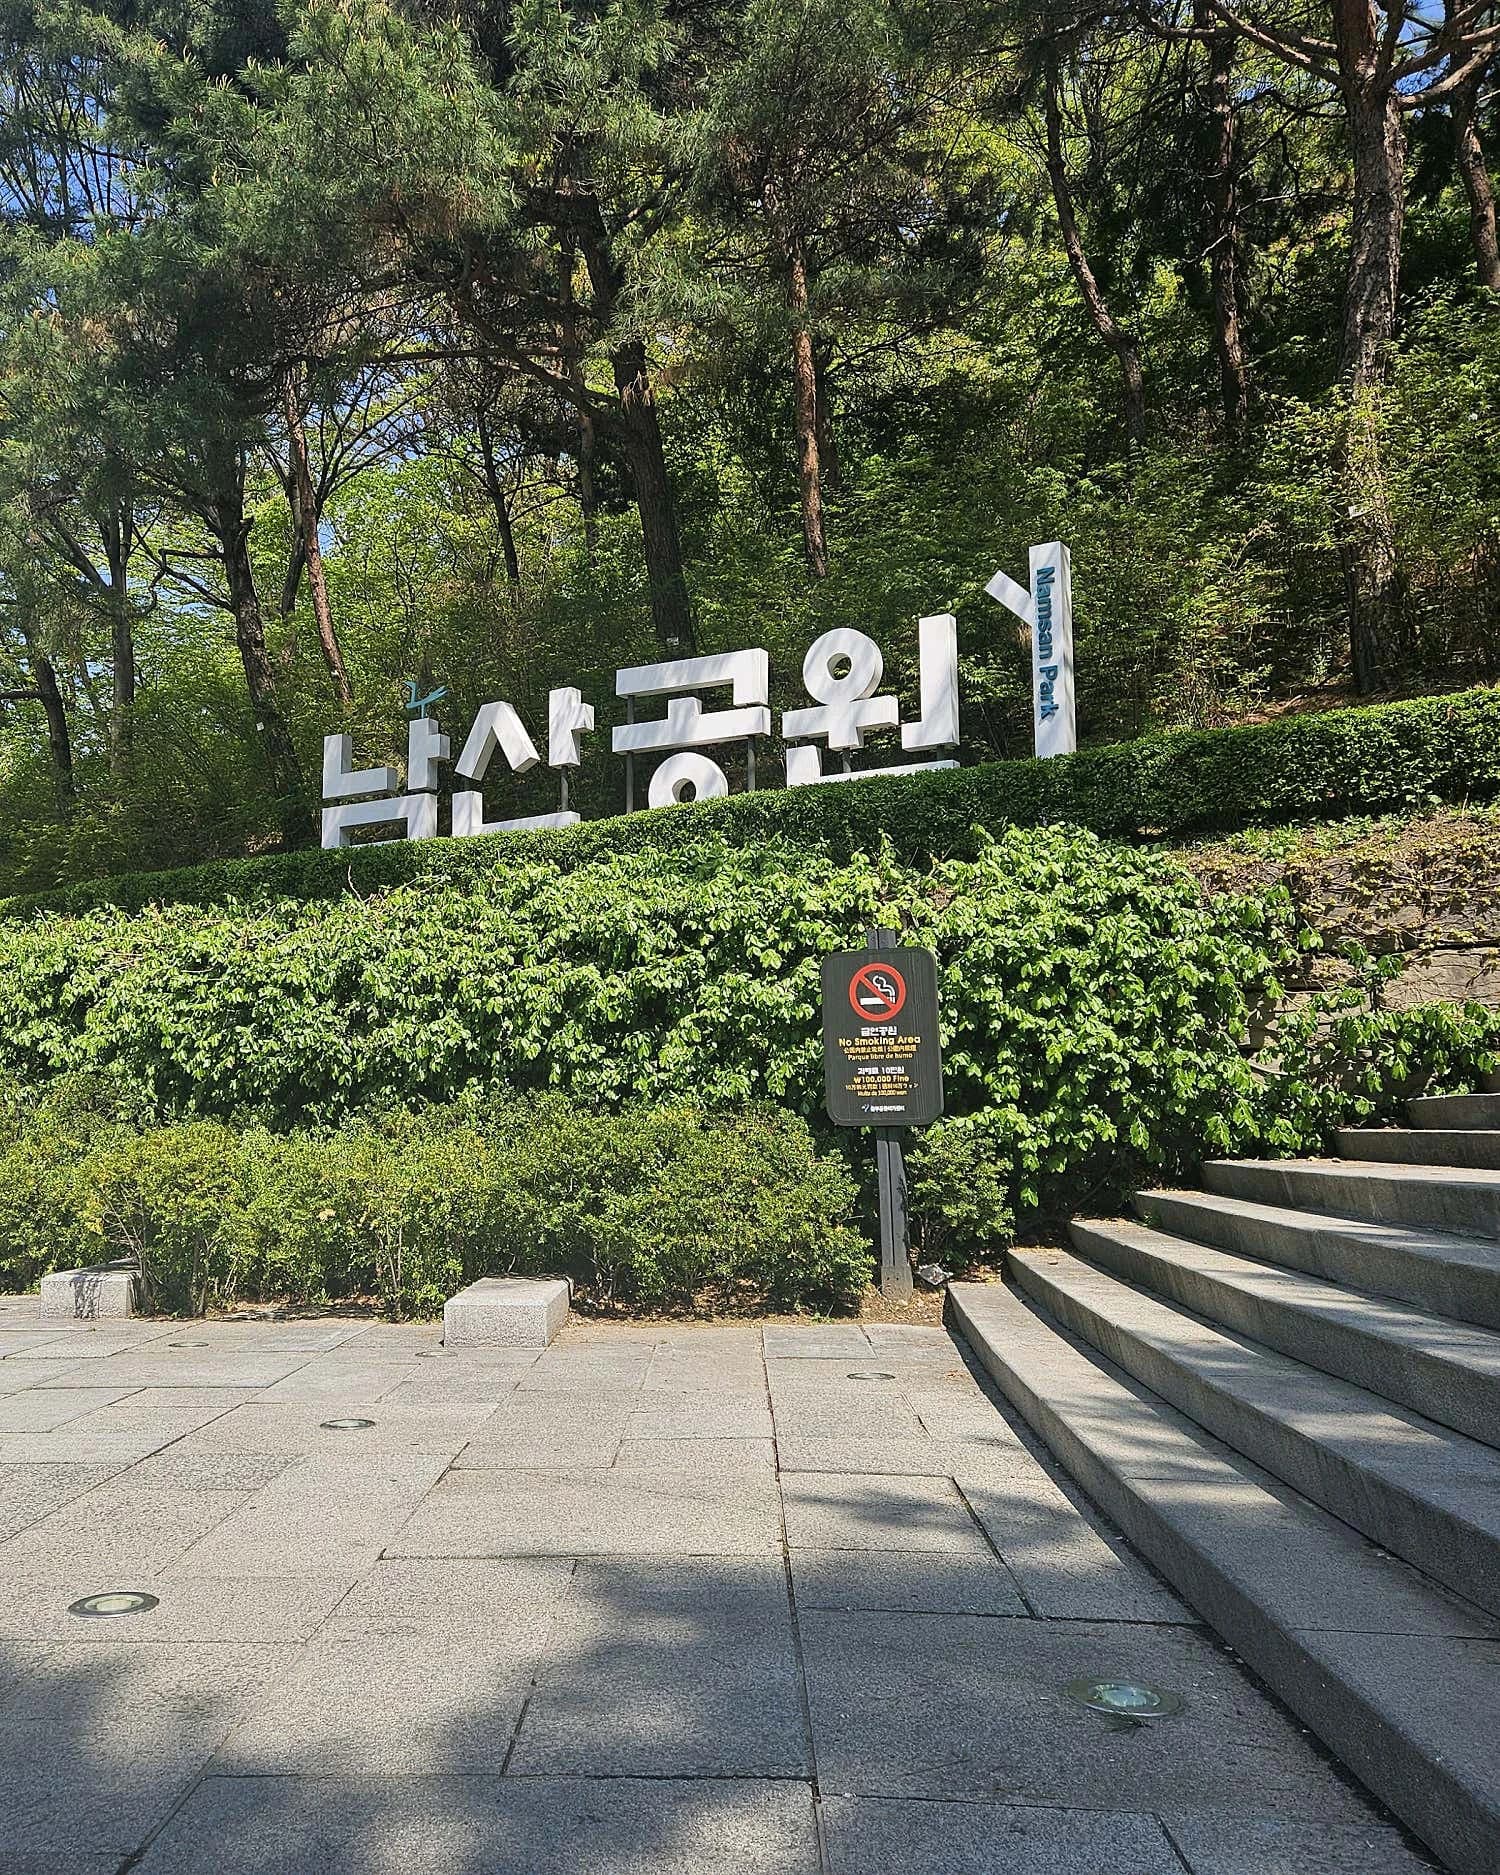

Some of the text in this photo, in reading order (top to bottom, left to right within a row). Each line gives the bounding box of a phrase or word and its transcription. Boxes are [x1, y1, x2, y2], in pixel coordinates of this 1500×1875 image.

[1036, 566, 1059, 721] Namsan Park
[322, 613, 960, 850] 남산공원
[860, 1025, 898, 1037] 금연공원
[838, 1036, 921, 1047] No Smoking Area
[847, 1053, 870, 1062] Parque
[892, 1074, 910, 1082] Fine
